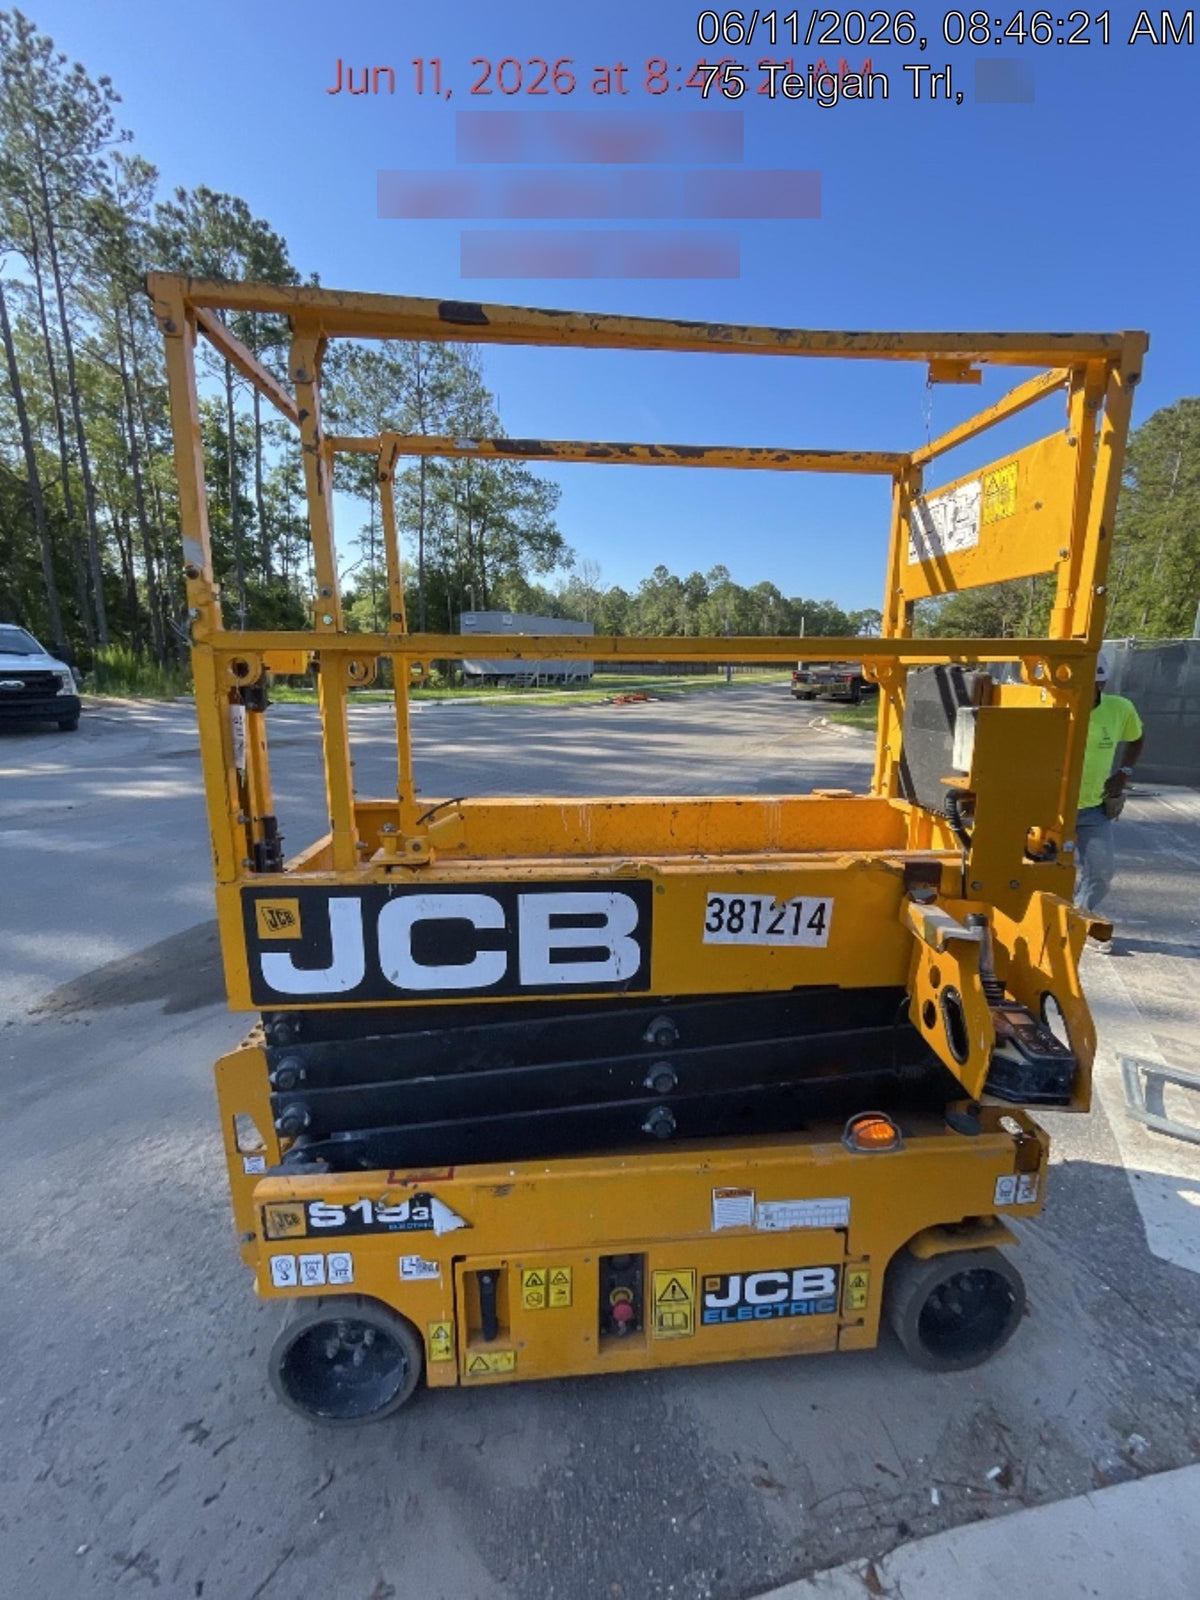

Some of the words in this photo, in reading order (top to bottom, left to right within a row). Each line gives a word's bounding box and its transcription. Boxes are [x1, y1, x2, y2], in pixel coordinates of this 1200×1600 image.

[705, 897, 826, 936] 381214
[261, 892, 640, 994] JCB
[705, 1267, 836, 1307] JCB
[704, 1299, 836, 1323] ELECTRIC
